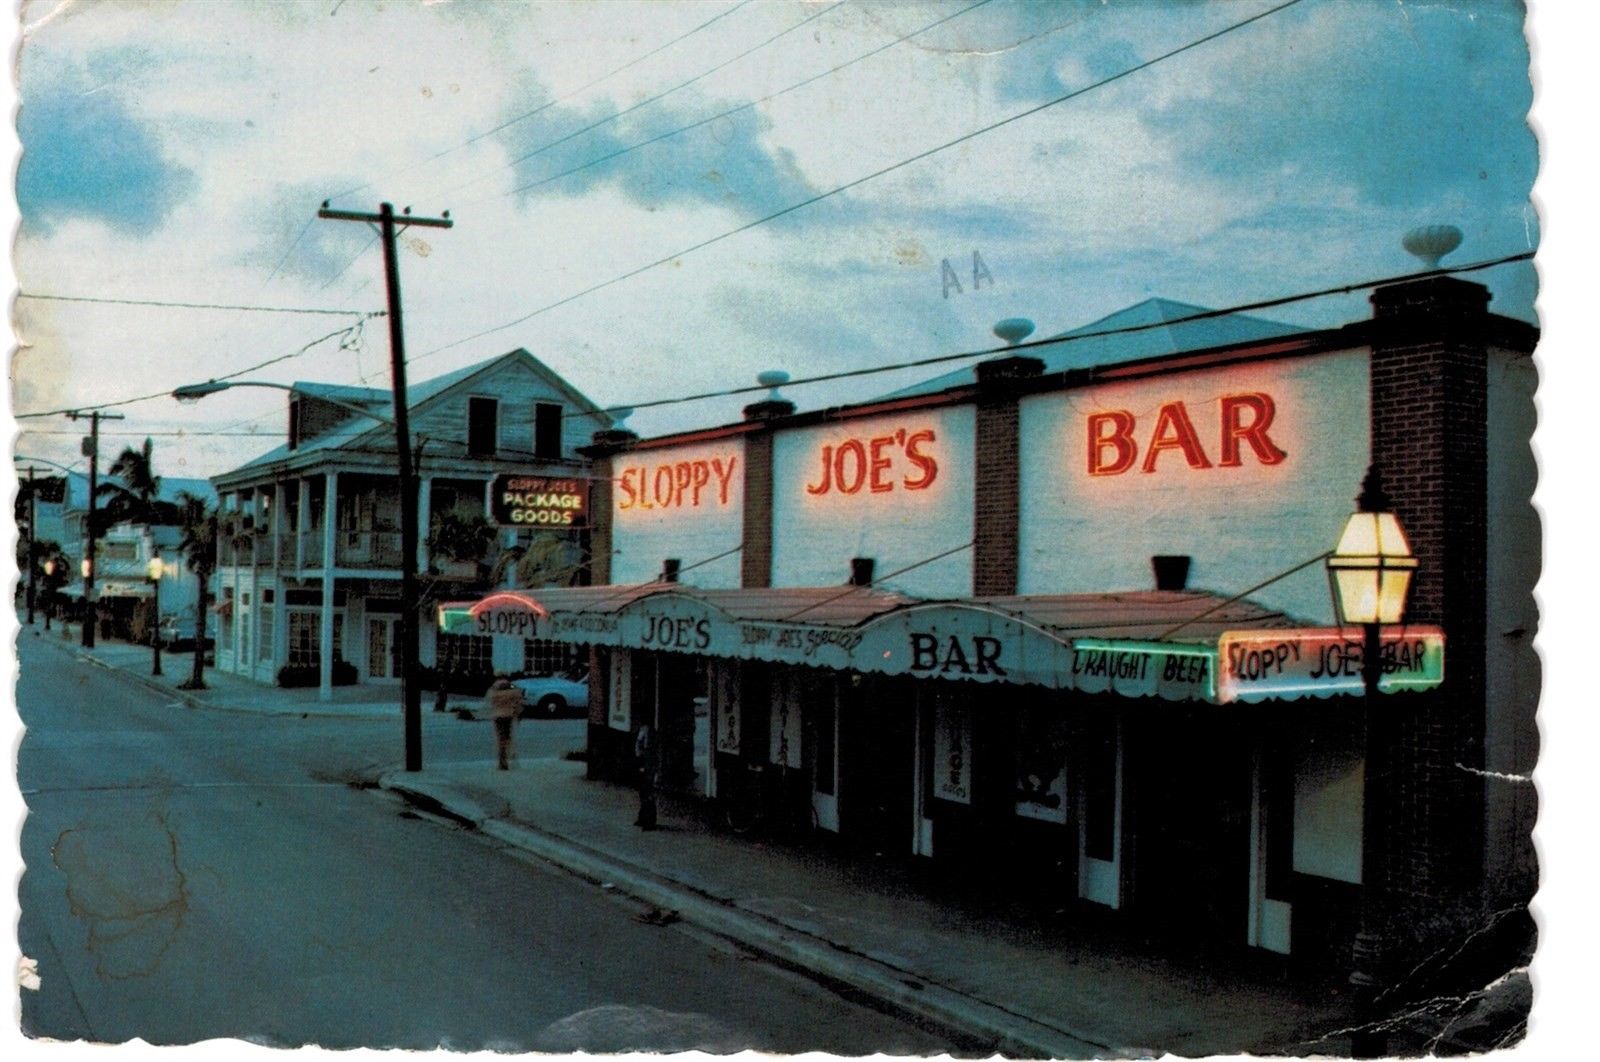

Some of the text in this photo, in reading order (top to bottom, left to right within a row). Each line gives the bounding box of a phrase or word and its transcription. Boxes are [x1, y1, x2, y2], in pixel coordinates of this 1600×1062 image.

[618, 391, 1287, 511] SLOPPY JOE'S BAR
[502, 491, 582, 510] PACKAGE
[510, 508, 573, 525] GOODS
[478, 610, 539, 637] SLOPPY
[642, 616, 712, 650] JOE'S
[911, 632, 1007, 677] BAR
[1229, 640, 1302, 681] SLOPPY
[1379, 640, 1425, 675] BAR
